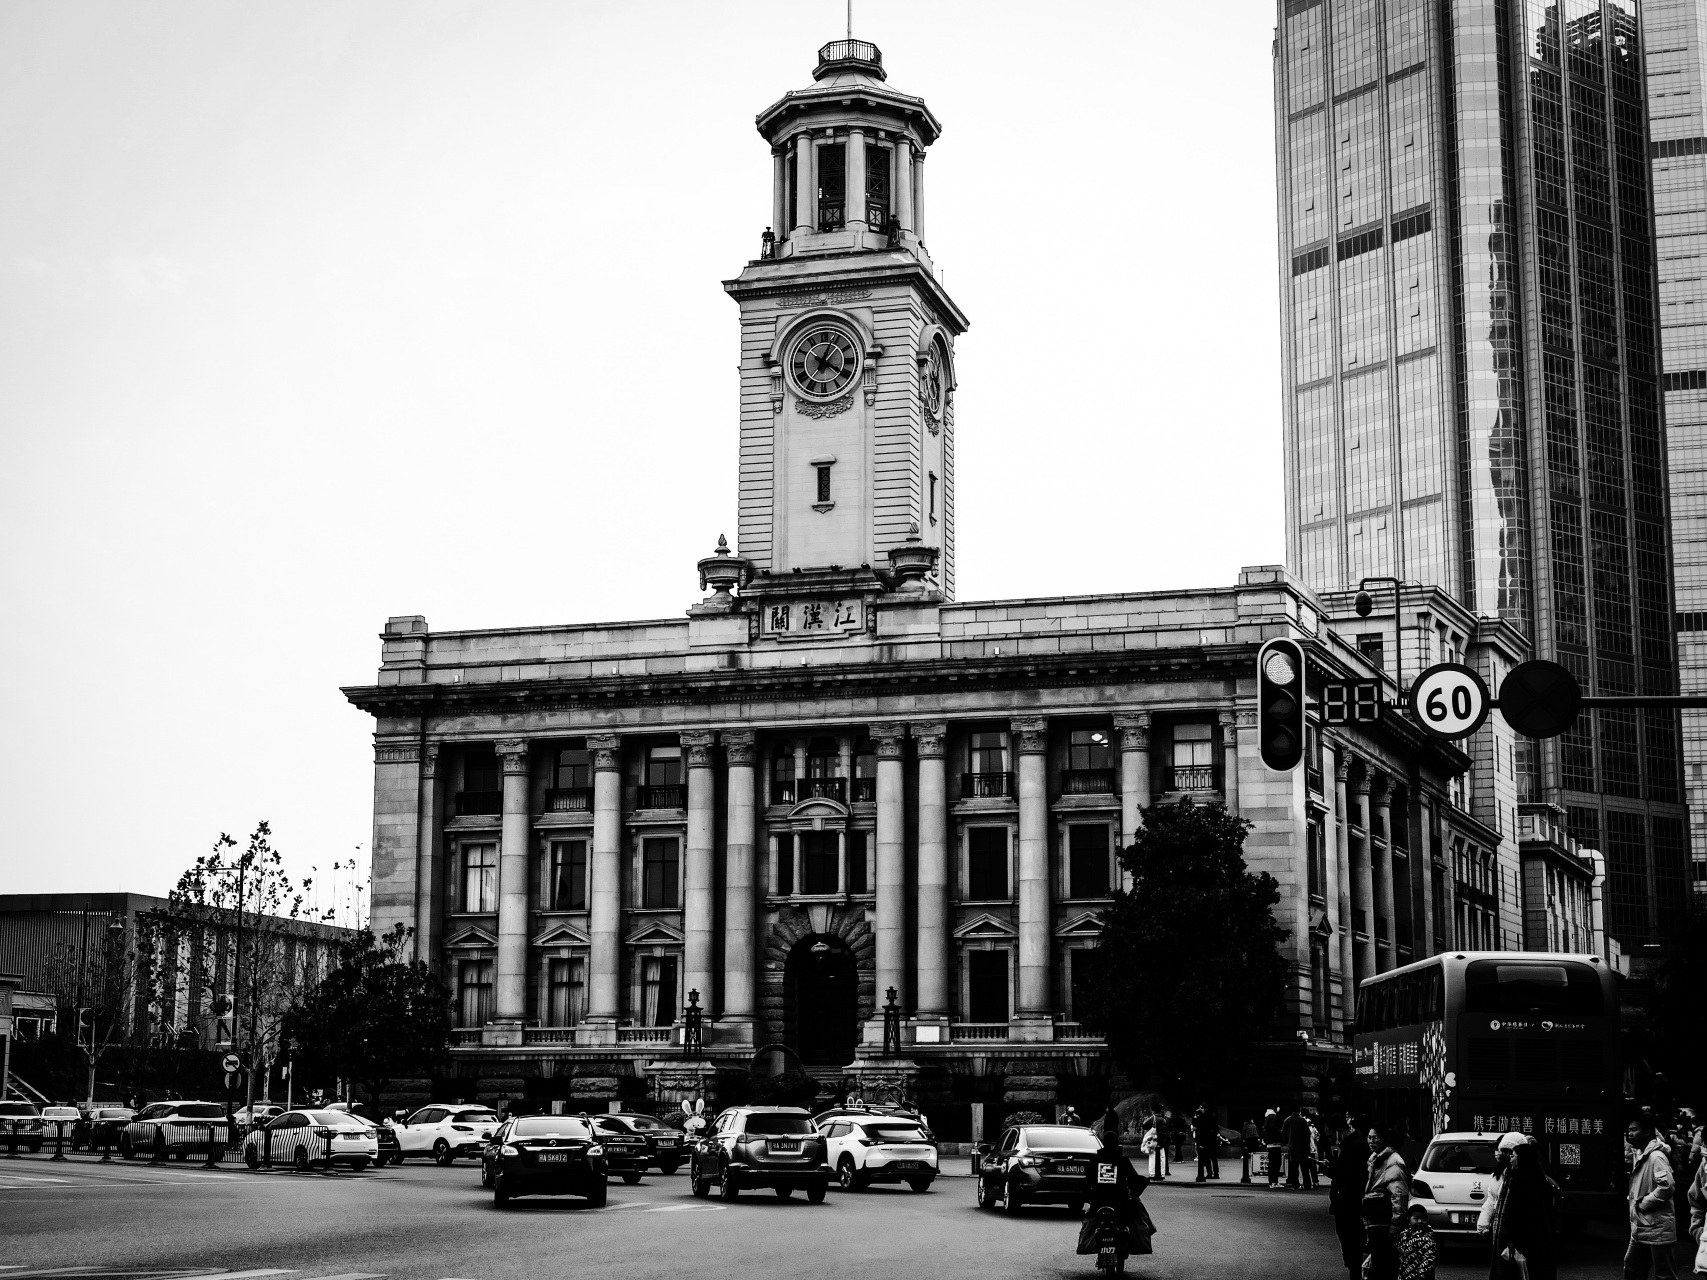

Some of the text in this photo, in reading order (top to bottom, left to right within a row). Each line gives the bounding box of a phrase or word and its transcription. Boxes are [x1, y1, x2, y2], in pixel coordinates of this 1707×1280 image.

[1425, 685, 1472, 722] 60
[1473, 1115, 1604, 1135] 携手做慈善 传播真善美
